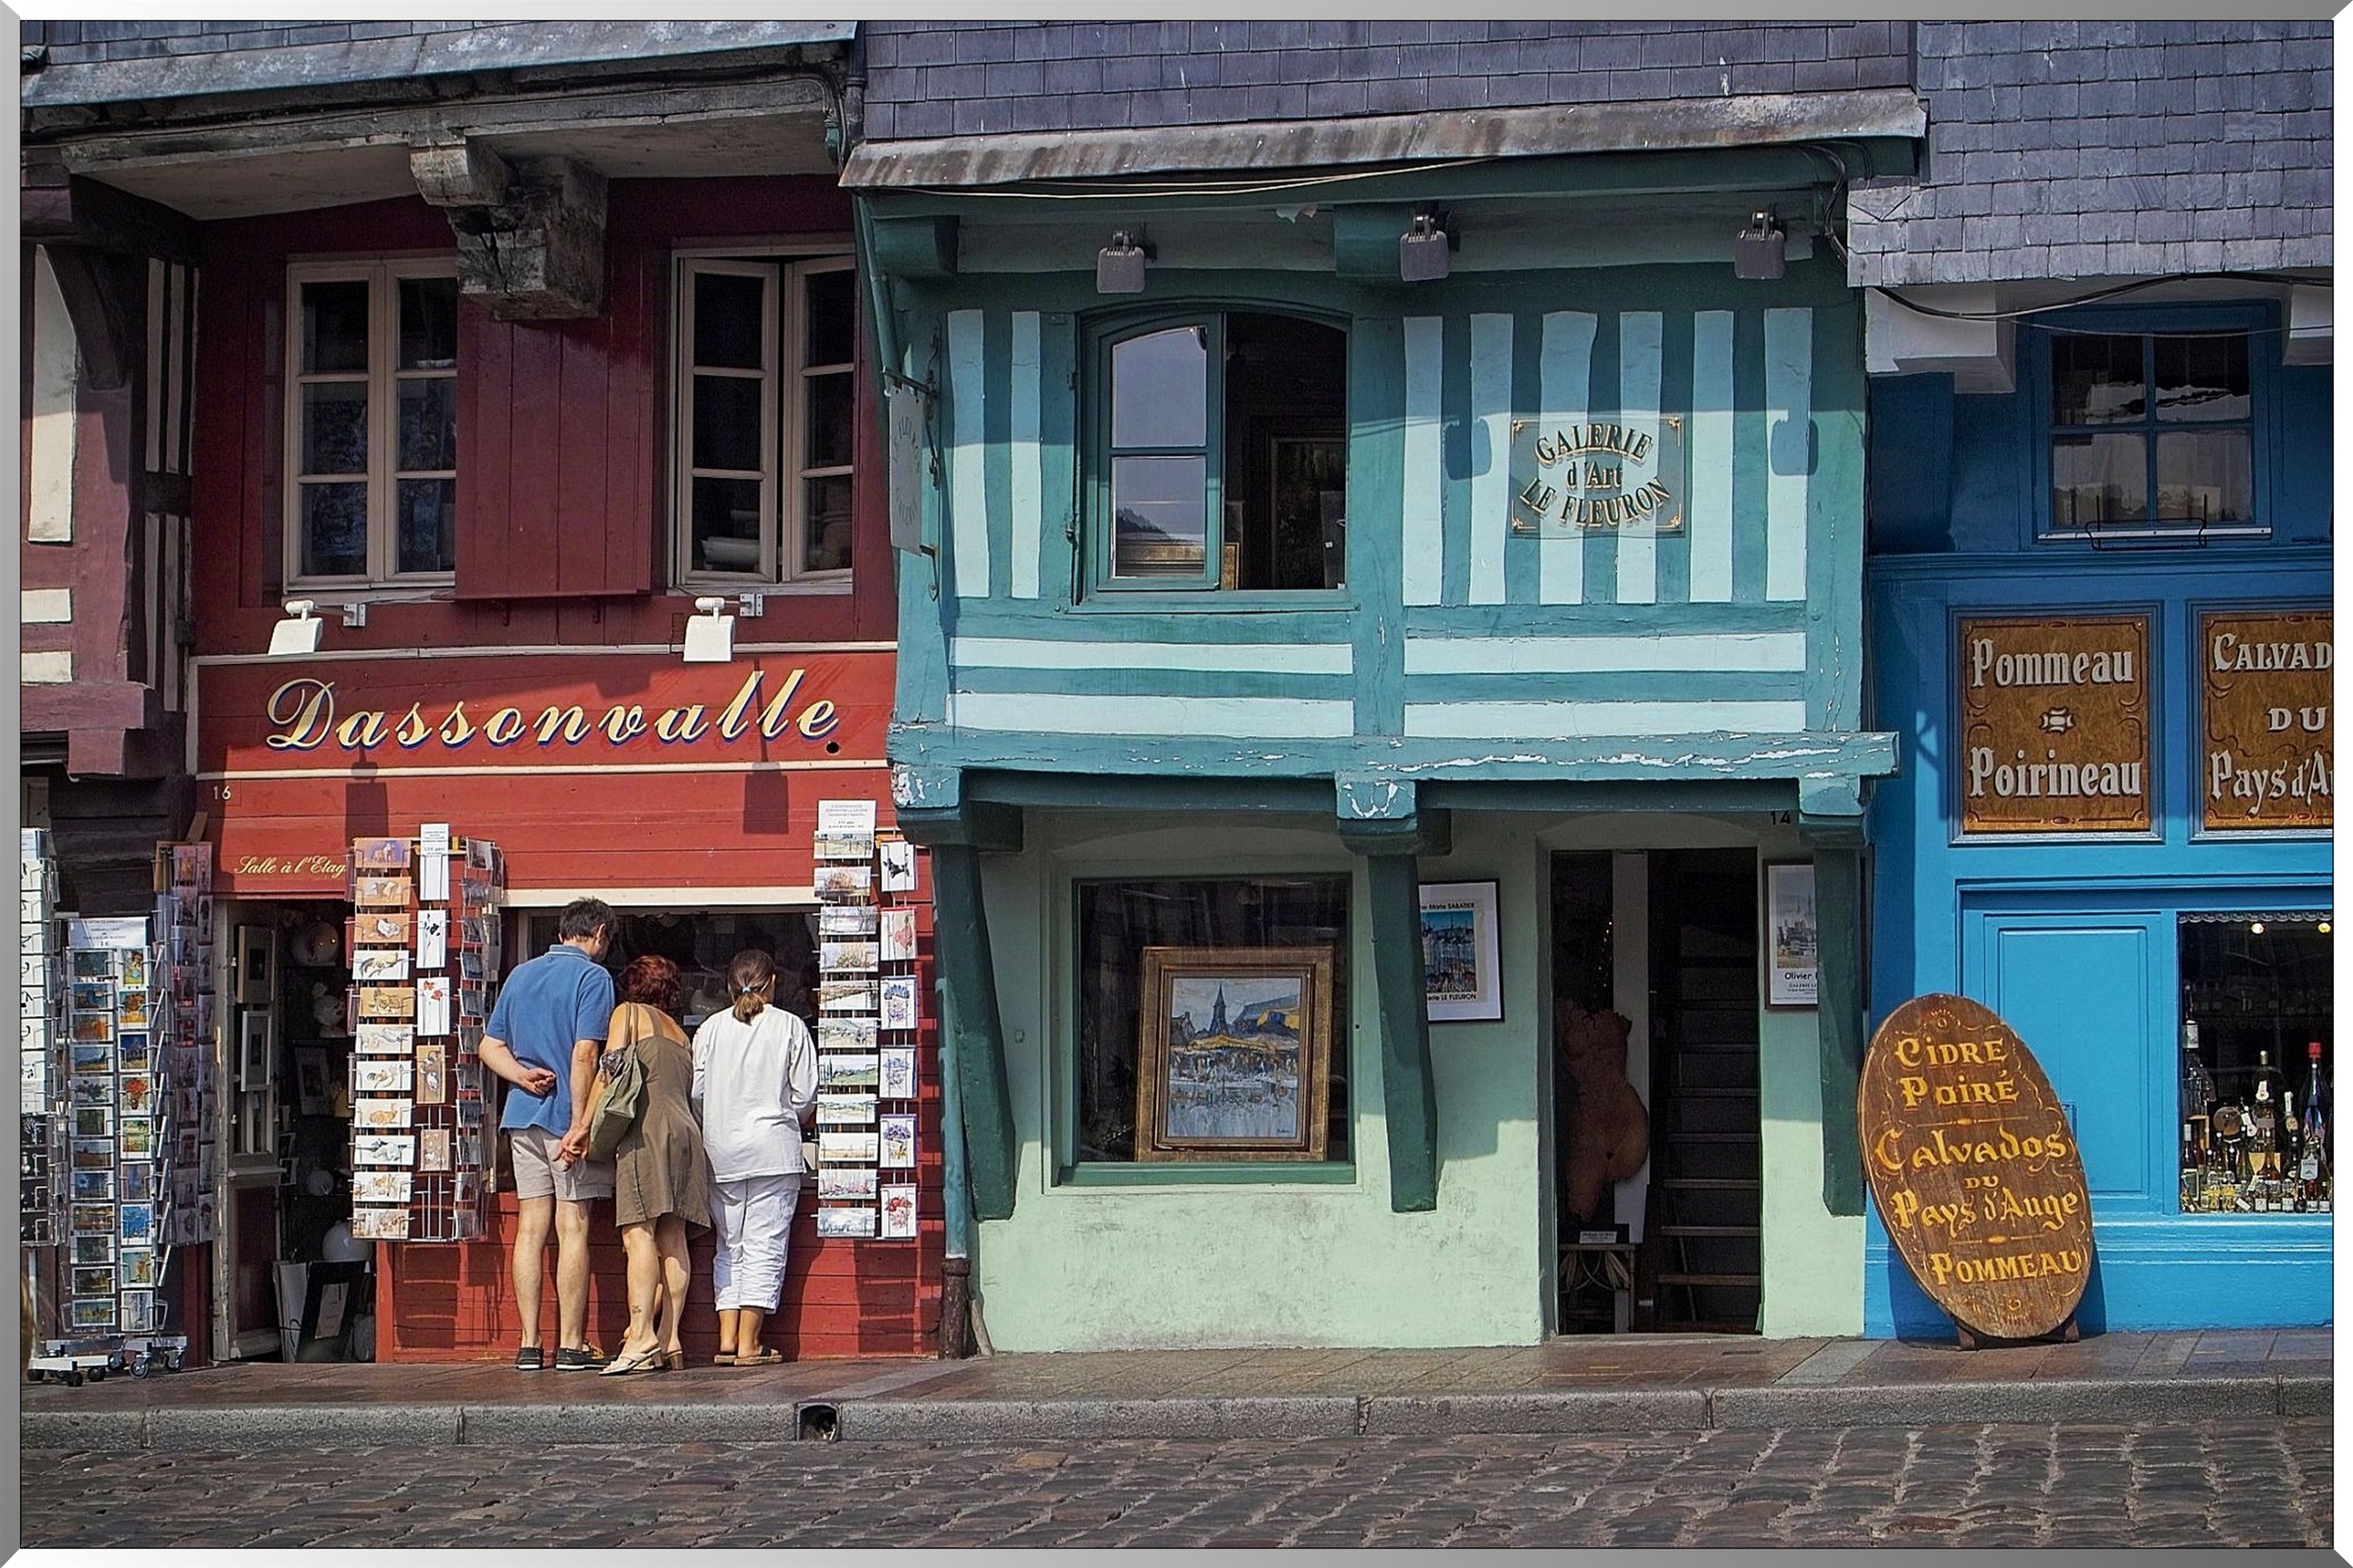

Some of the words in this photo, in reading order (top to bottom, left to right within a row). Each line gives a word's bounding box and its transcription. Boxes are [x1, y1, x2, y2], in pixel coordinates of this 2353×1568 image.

[1534, 423, 1653, 466] GALERIE
[1567, 461, 1623, 489] d'Art
[1519, 477, 1556, 514] LE
[1560, 476, 1671, 527] FLEURON
[1971, 636, 2135, 687] Pommeau
[266, 669, 840, 751] Dassonvalle
[2268, 707, 2328, 731] DU
[1968, 747, 2142, 797] Poirineau
[2210, 750, 2287, 814] Pays
[2292, 750, 2333, 805] d'A
[213, 786, 231, 800] 16
[1771, 811, 1791, 825] 14
[234, 855, 276, 874] Salle
[280, 861, 292, 874] à
[294, 855, 346, 879] l'Etag
[1784, 971, 1813, 980] Olivier
[1875, 1121, 2067, 1172] Calvados
[1963, 1175, 1999, 1189] DU
[1891, 1189, 1977, 1239] Pays
[1984, 1187, 2078, 1231] d'Auge
[1930, 1249, 2082, 1286] POMMEAU
